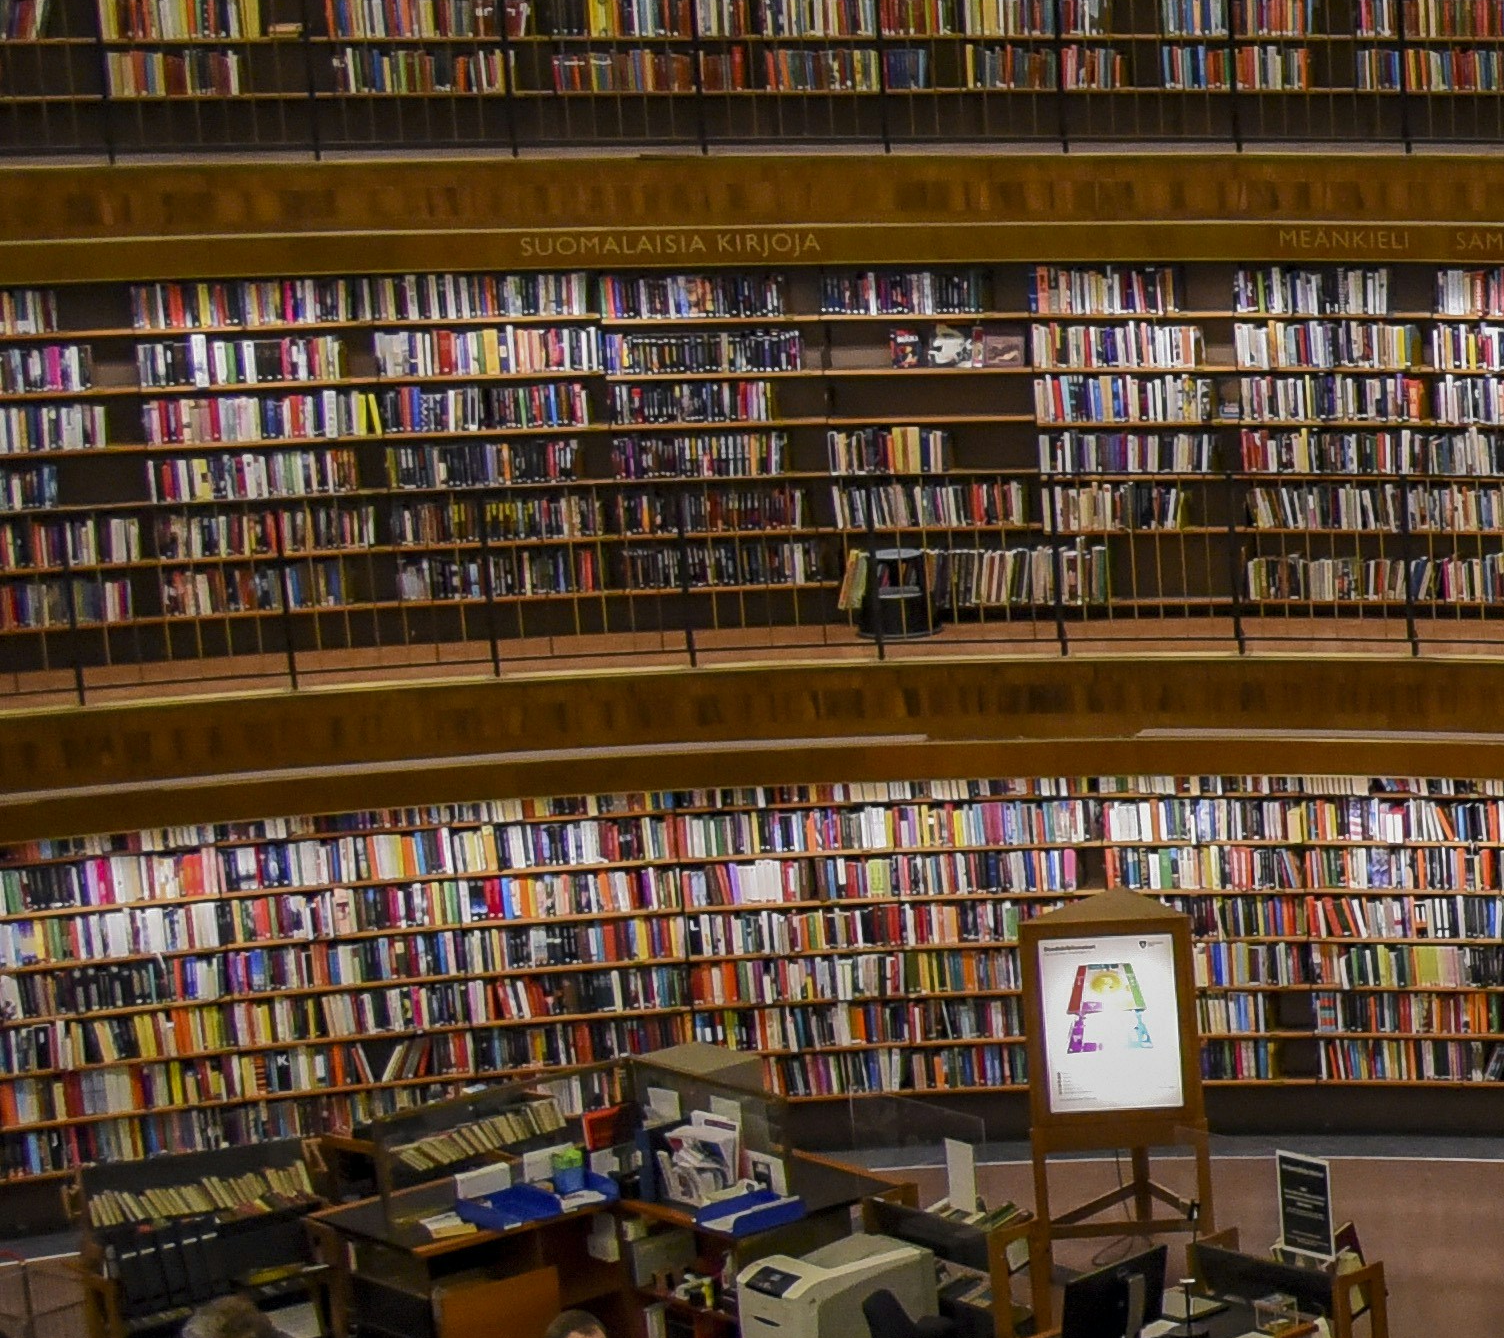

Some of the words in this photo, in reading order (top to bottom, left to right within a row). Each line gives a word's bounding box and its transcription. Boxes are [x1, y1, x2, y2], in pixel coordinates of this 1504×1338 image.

[521, 233, 707, 257] SUOMALAISIA
[717, 233, 822, 257] KIRJOJA
[1279, 227, 1410, 250] MEÄNKIELI
[277, 1054, 289, 1066] K
